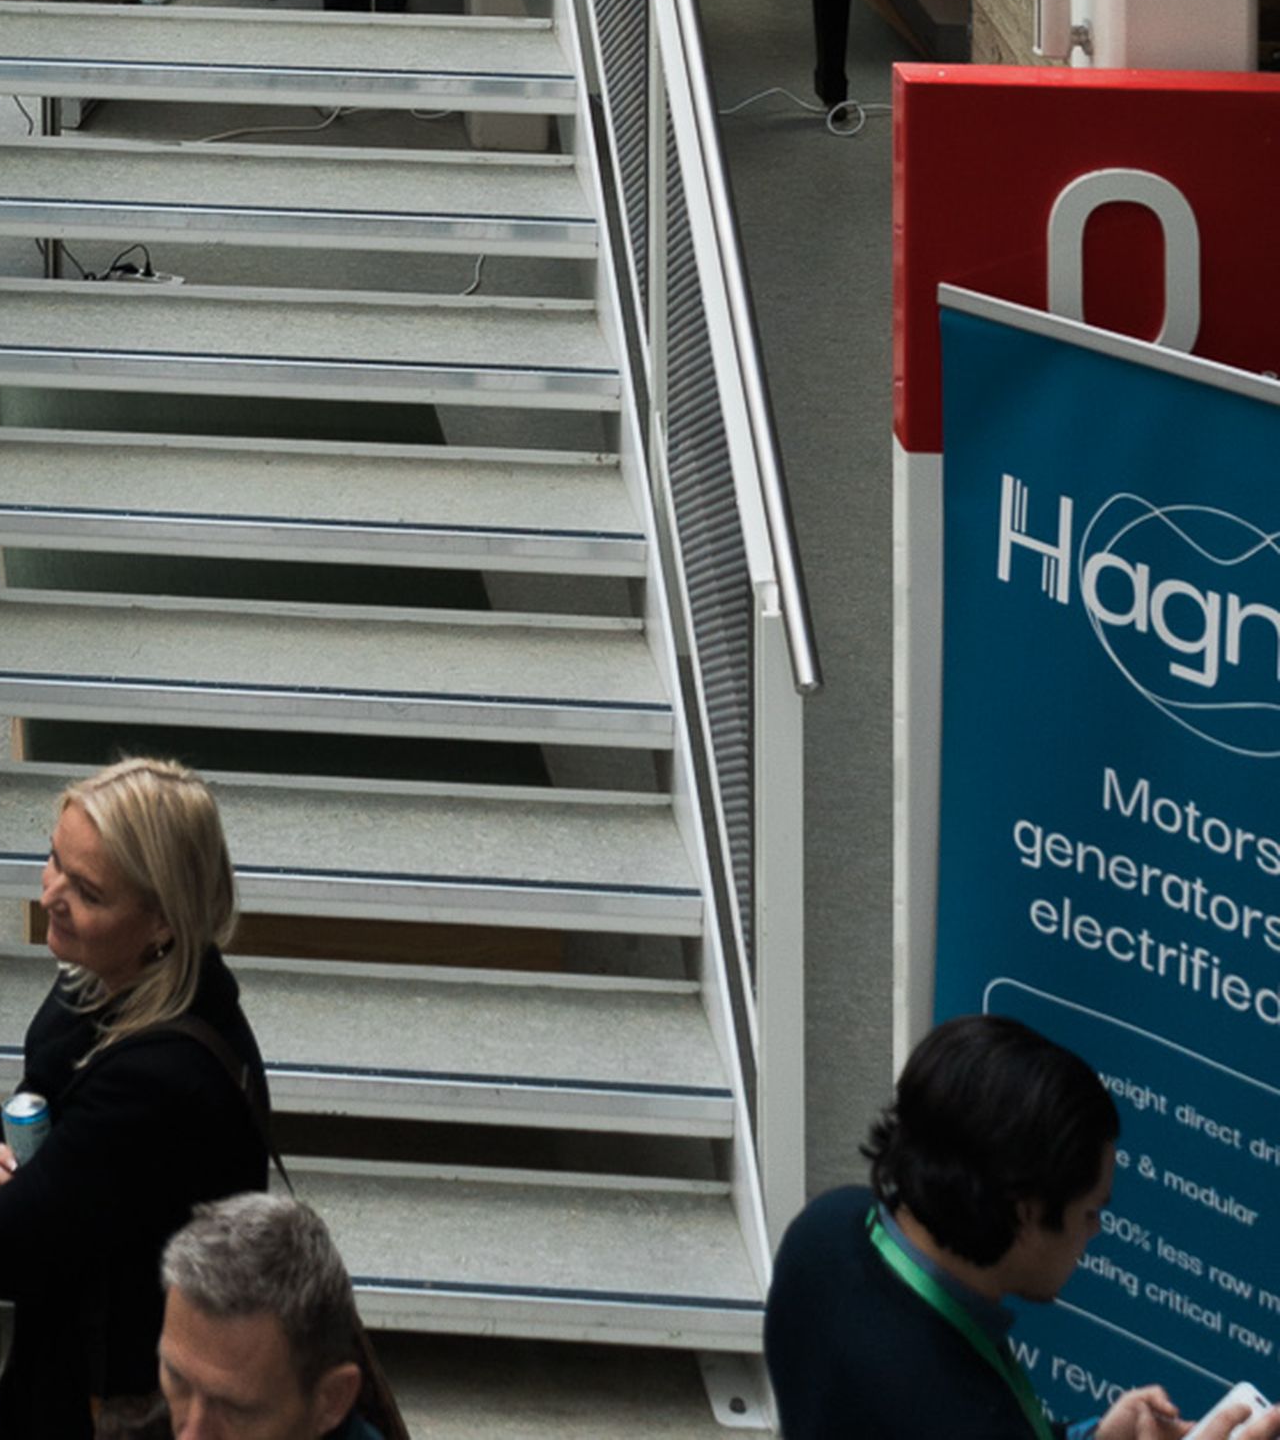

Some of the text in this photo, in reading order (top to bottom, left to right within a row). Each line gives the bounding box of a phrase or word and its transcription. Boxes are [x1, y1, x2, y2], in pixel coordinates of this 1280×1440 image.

[1047, 166, 1201, 355] 0
[1102, 766, 1280, 876] Motors
[1013, 818, 1280, 952] generators
[1175, 1104, 1243, 1150] direct
[1137, 1154, 1158, 1181] &
[1163, 1169, 1260, 1227] modular
[1099, 1209, 1254, 1300] 90% less raw
[1144, 1282, 1223, 1333] critical
[1228, 1322, 1274, 1356] raw
